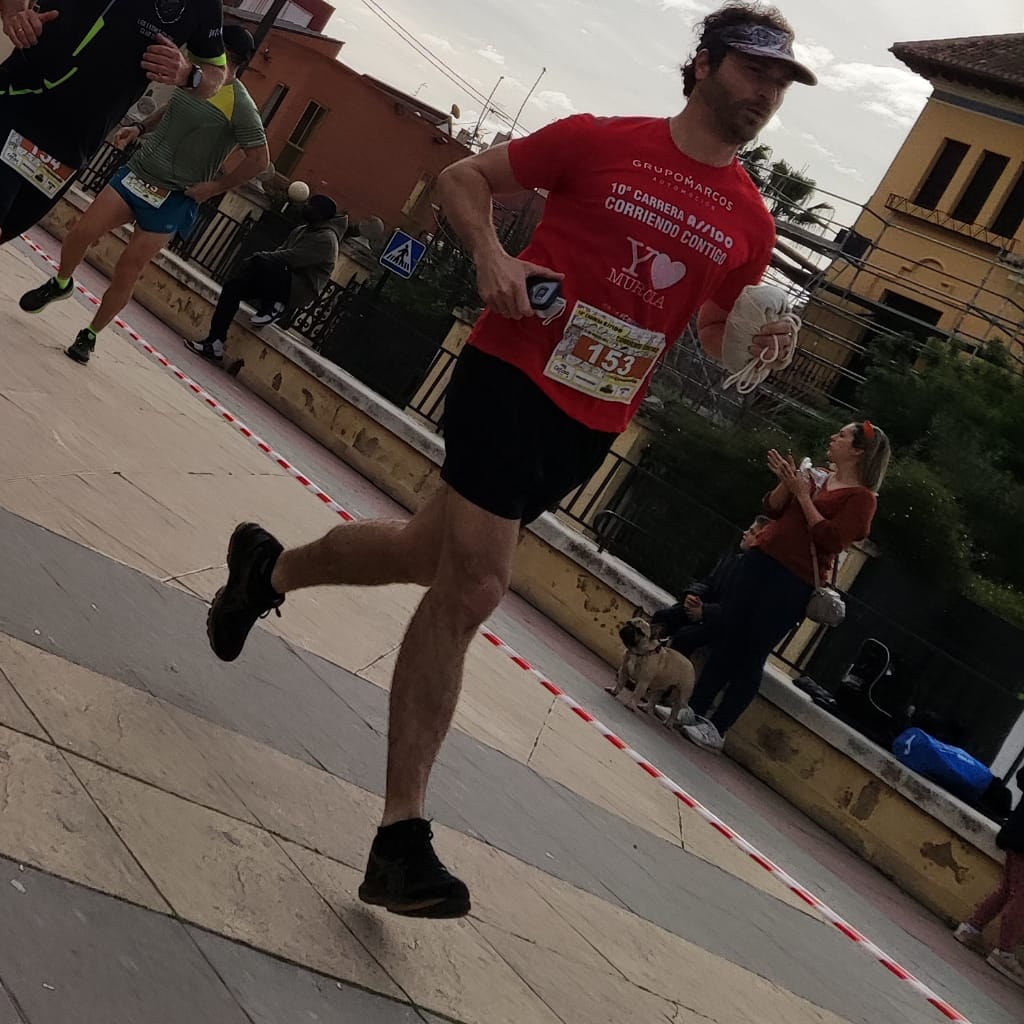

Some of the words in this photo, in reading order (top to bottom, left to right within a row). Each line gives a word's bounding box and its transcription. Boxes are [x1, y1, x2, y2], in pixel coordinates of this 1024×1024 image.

[631, 158, 735, 212] GRUPOMARCOS
[632, 189, 685, 222] CARRERA
[604, 195, 681, 238] CORRIENDO
[679, 229, 728, 266] CONTIGO
[621, 236, 661, 277] Y
[606, 267, 665, 310] MURCIA
[586, 343, 636, 376] 153
